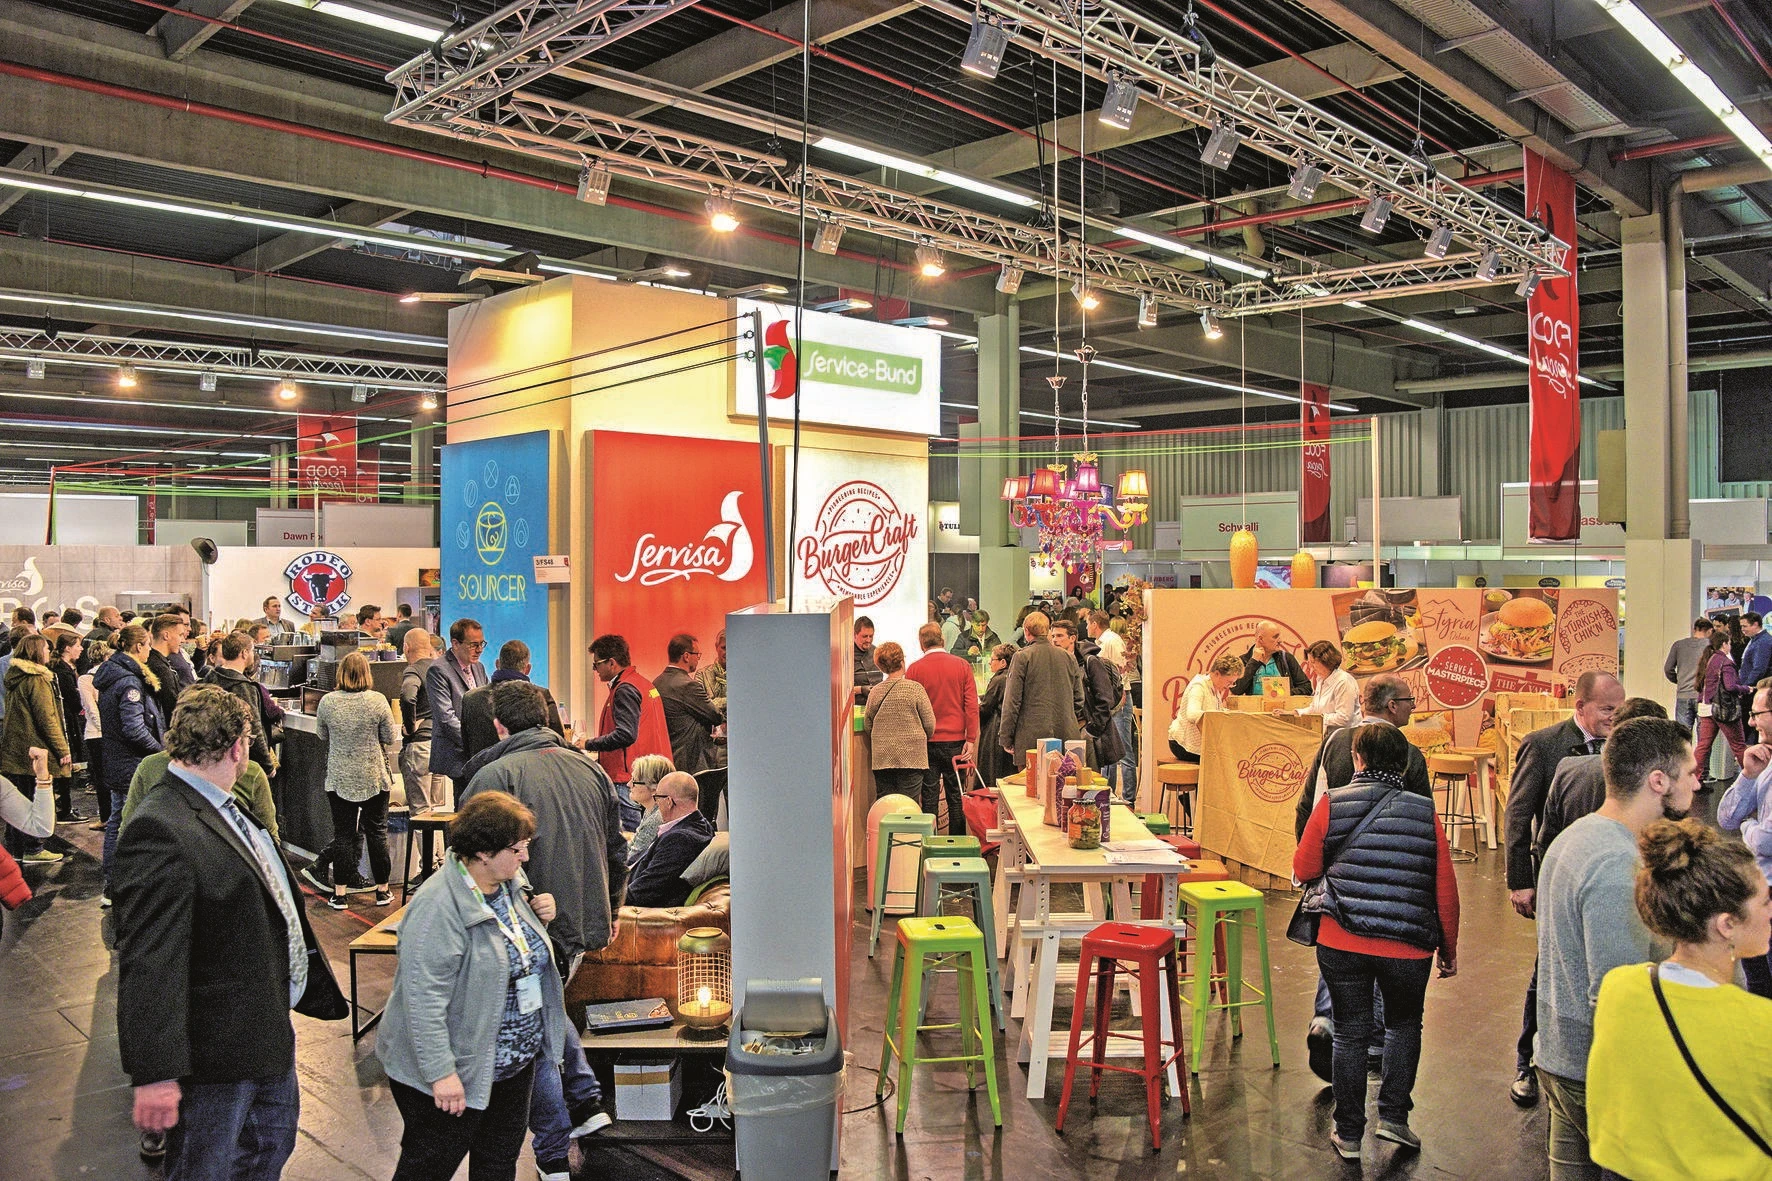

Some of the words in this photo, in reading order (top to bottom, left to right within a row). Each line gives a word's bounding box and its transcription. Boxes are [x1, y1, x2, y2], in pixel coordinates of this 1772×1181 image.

[803, 350, 917, 385] Service-Bund
[283, 532, 308, 540] Dawn
[1218, 522, 1259, 532] Schwalli
[289, 553, 351, 580] RODEO
[614, 533, 725, 583] Servisa
[458, 574, 526, 601] SOURCER
[1415, 608, 1477, 640] Styria
[1565, 609, 1602, 635] TURKISH
[1574, 609, 1585, 618] THE
[1206, 624, 1243, 651] PIONEERING
[1573, 621, 1604, 644] CHIK'N
[1427, 667, 1487, 689] MASTERPIECE
[1445, 661, 1467, 675] SERVE
[1495, 678, 1516, 691] THE
